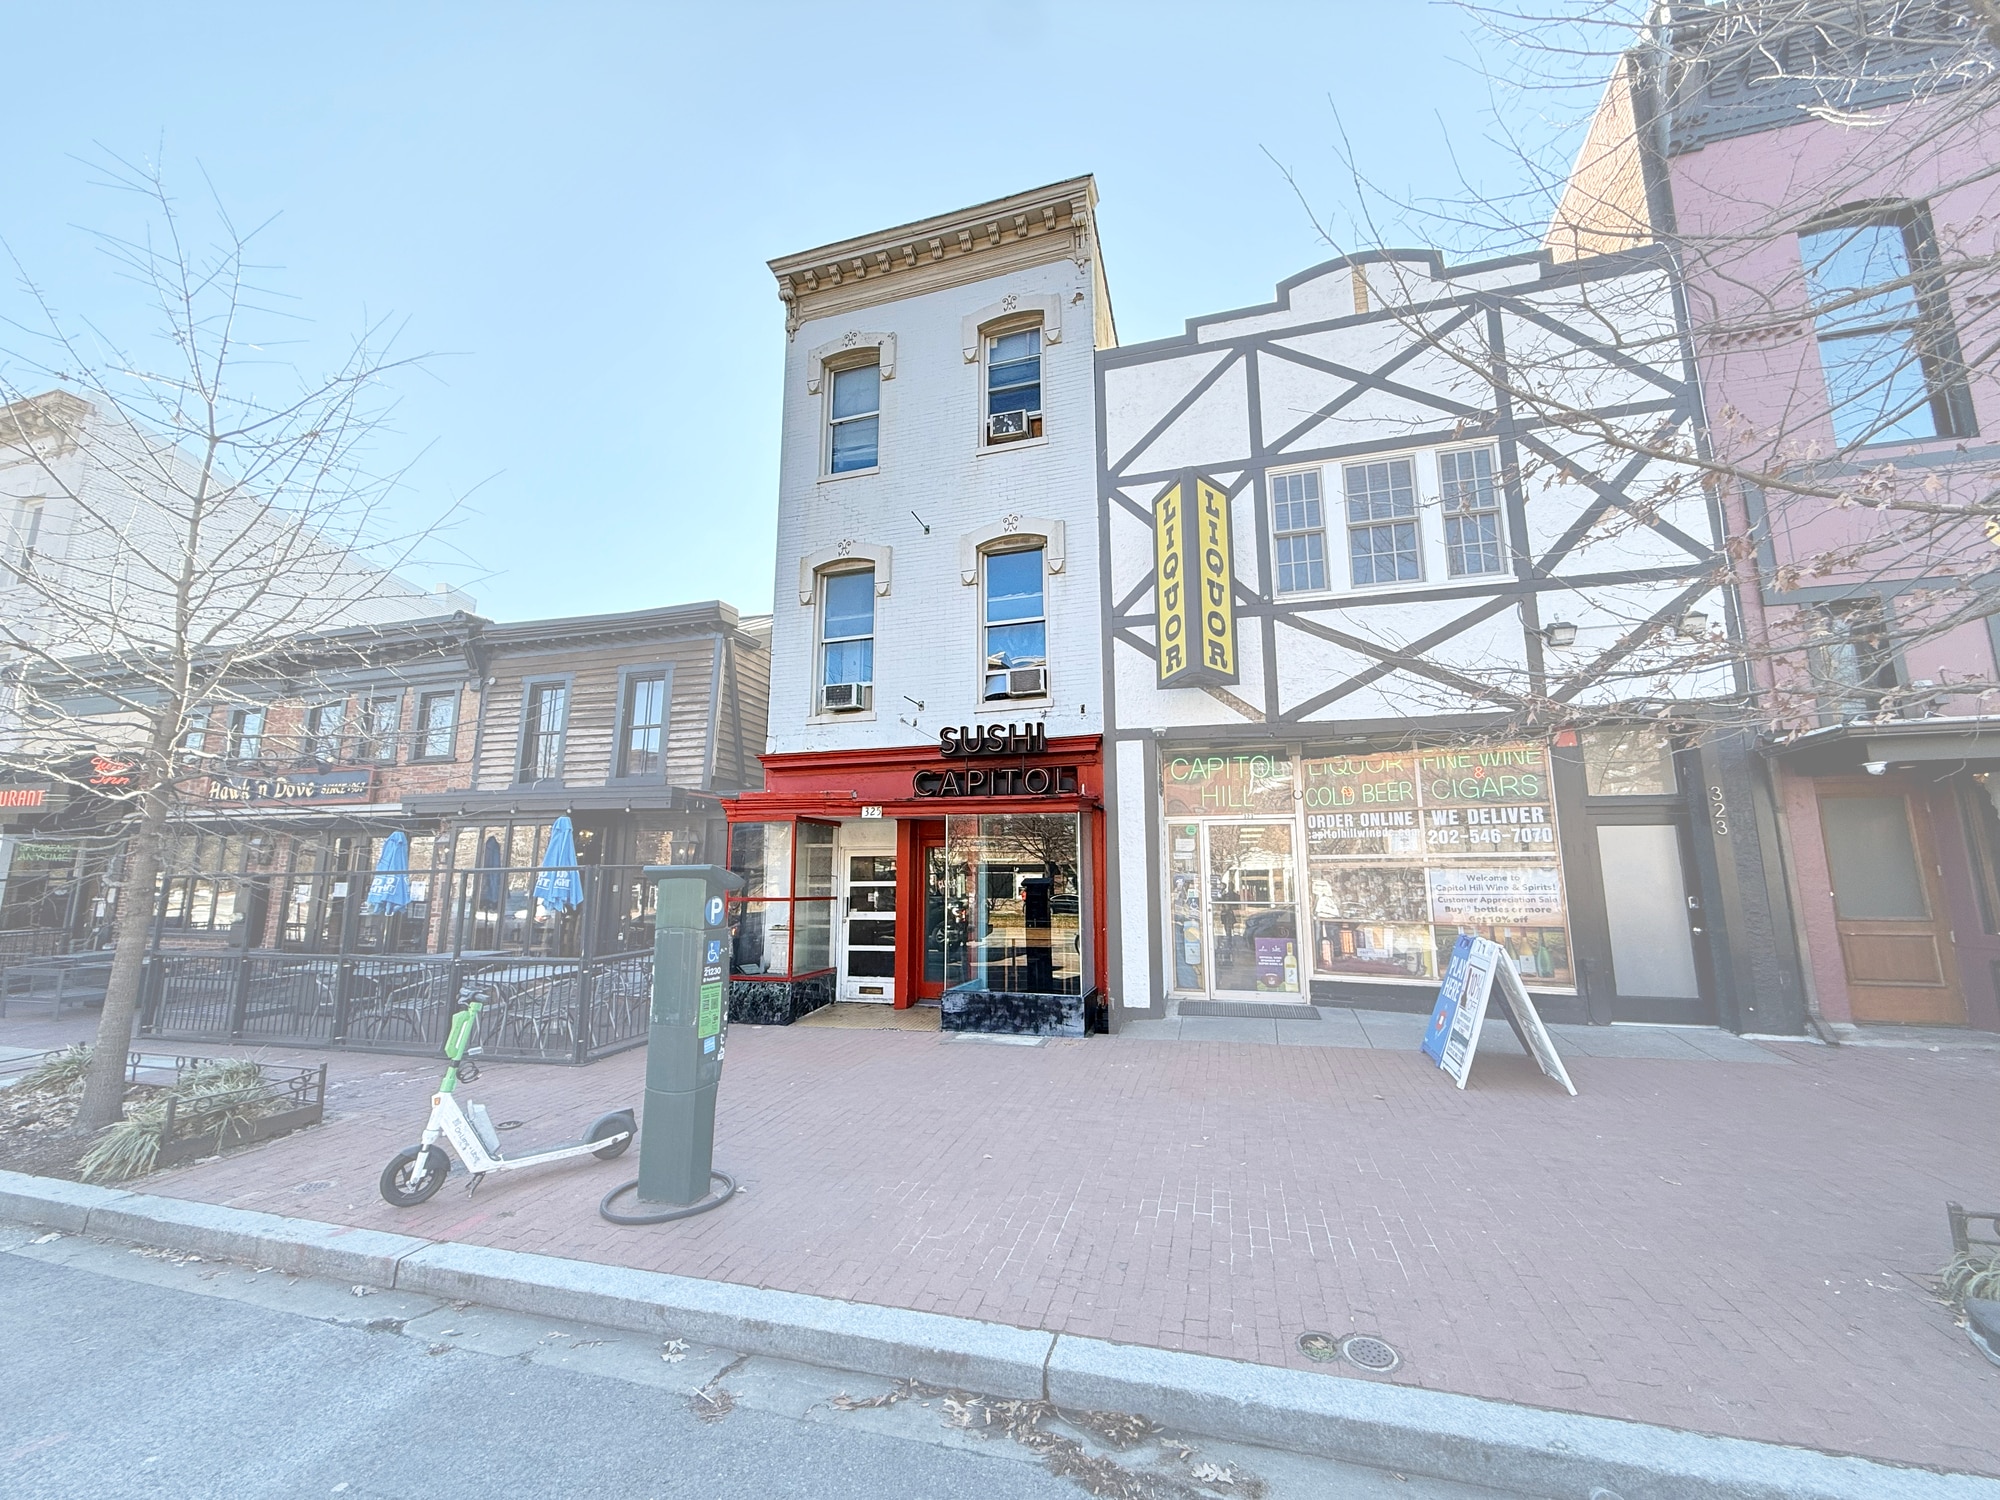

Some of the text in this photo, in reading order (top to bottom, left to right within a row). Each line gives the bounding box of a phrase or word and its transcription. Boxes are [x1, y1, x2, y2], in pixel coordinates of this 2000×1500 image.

[1163, 498, 1182, 674] LIQUOR
[1205, 488, 1228, 670] LIQUOR
[939, 722, 1044, 755] SUSHI
[1170, 755, 1286, 781] CAPITOL
[1308, 756, 1404, 776] LIQUOR
[1422, 743, 1543, 770] FINE WINE
[913, 767, 1072, 797] CAPITOL
[1474, 766, 1485, 779] &
[209, 779, 250, 800] Hawk
[274, 777, 315, 798] Dove
[1201, 784, 1255, 807] HILL
[1306, 781, 1414, 807] COLD BEER
[1431, 774, 1539, 800] CIGARS
[864, 806, 882, 817] 325
[1307, 812, 1414, 829] ORDER ONLINE
[1431, 806, 1545, 826] WE DELIVER
[1711, 786, 1728, 835] 323
[1427, 827, 1554, 845] 202-546-7070
[1435, 884, 1467, 893] Capitol
[1469, 884, 1484, 892] Hill
[1523, 884, 1557, 892] Spirits!
[1466, 874, 1521, 882] Welcome to
[1445, 906, 1463, 914] Buy
[1480, 896, 1537, 905] Appreciation
[1449, 956, 1467, 980] PLAY
[1442, 978, 1462, 1002] HERE
